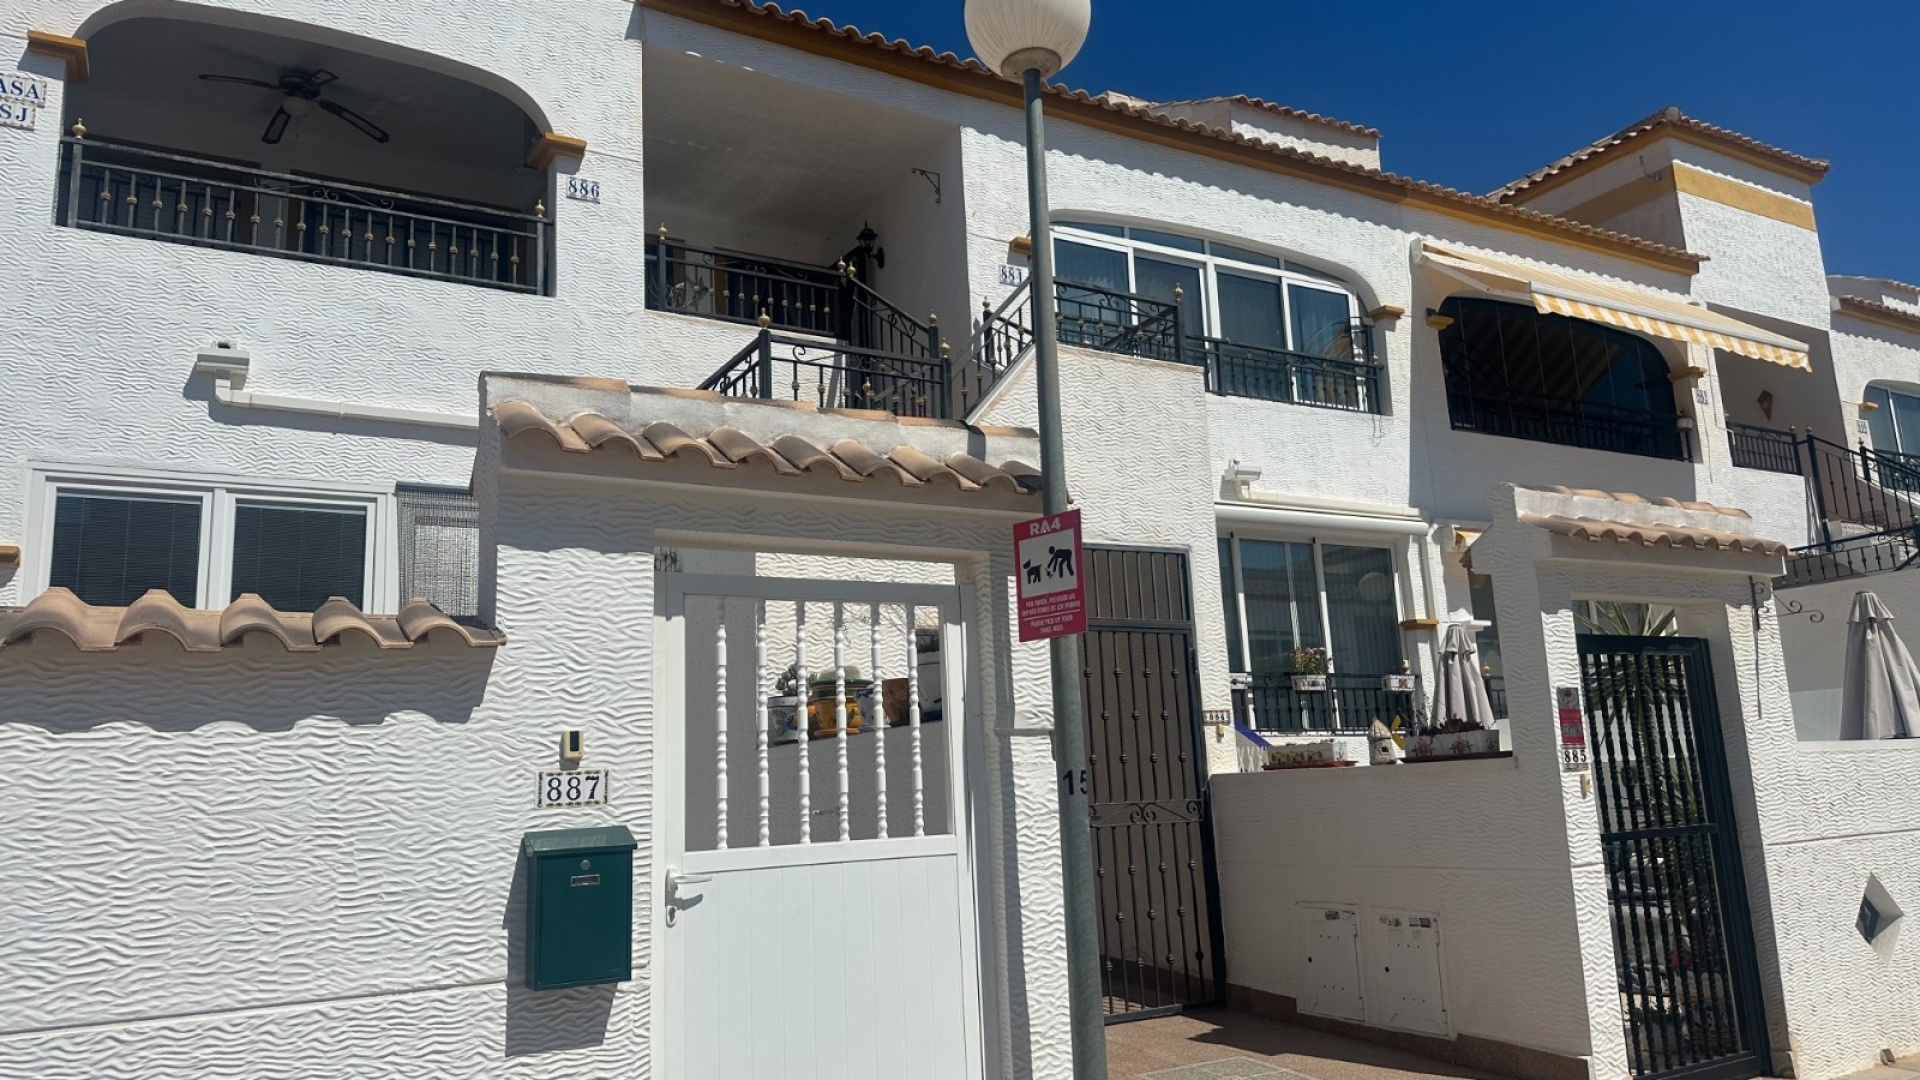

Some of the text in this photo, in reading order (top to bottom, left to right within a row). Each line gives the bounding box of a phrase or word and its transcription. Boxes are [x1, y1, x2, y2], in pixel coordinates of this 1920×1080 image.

[568, 179, 600, 198] 886
[1030, 517, 1061, 535] RA4
[1564, 749, 1587, 763] 885
[546, 775, 600, 802] 887
